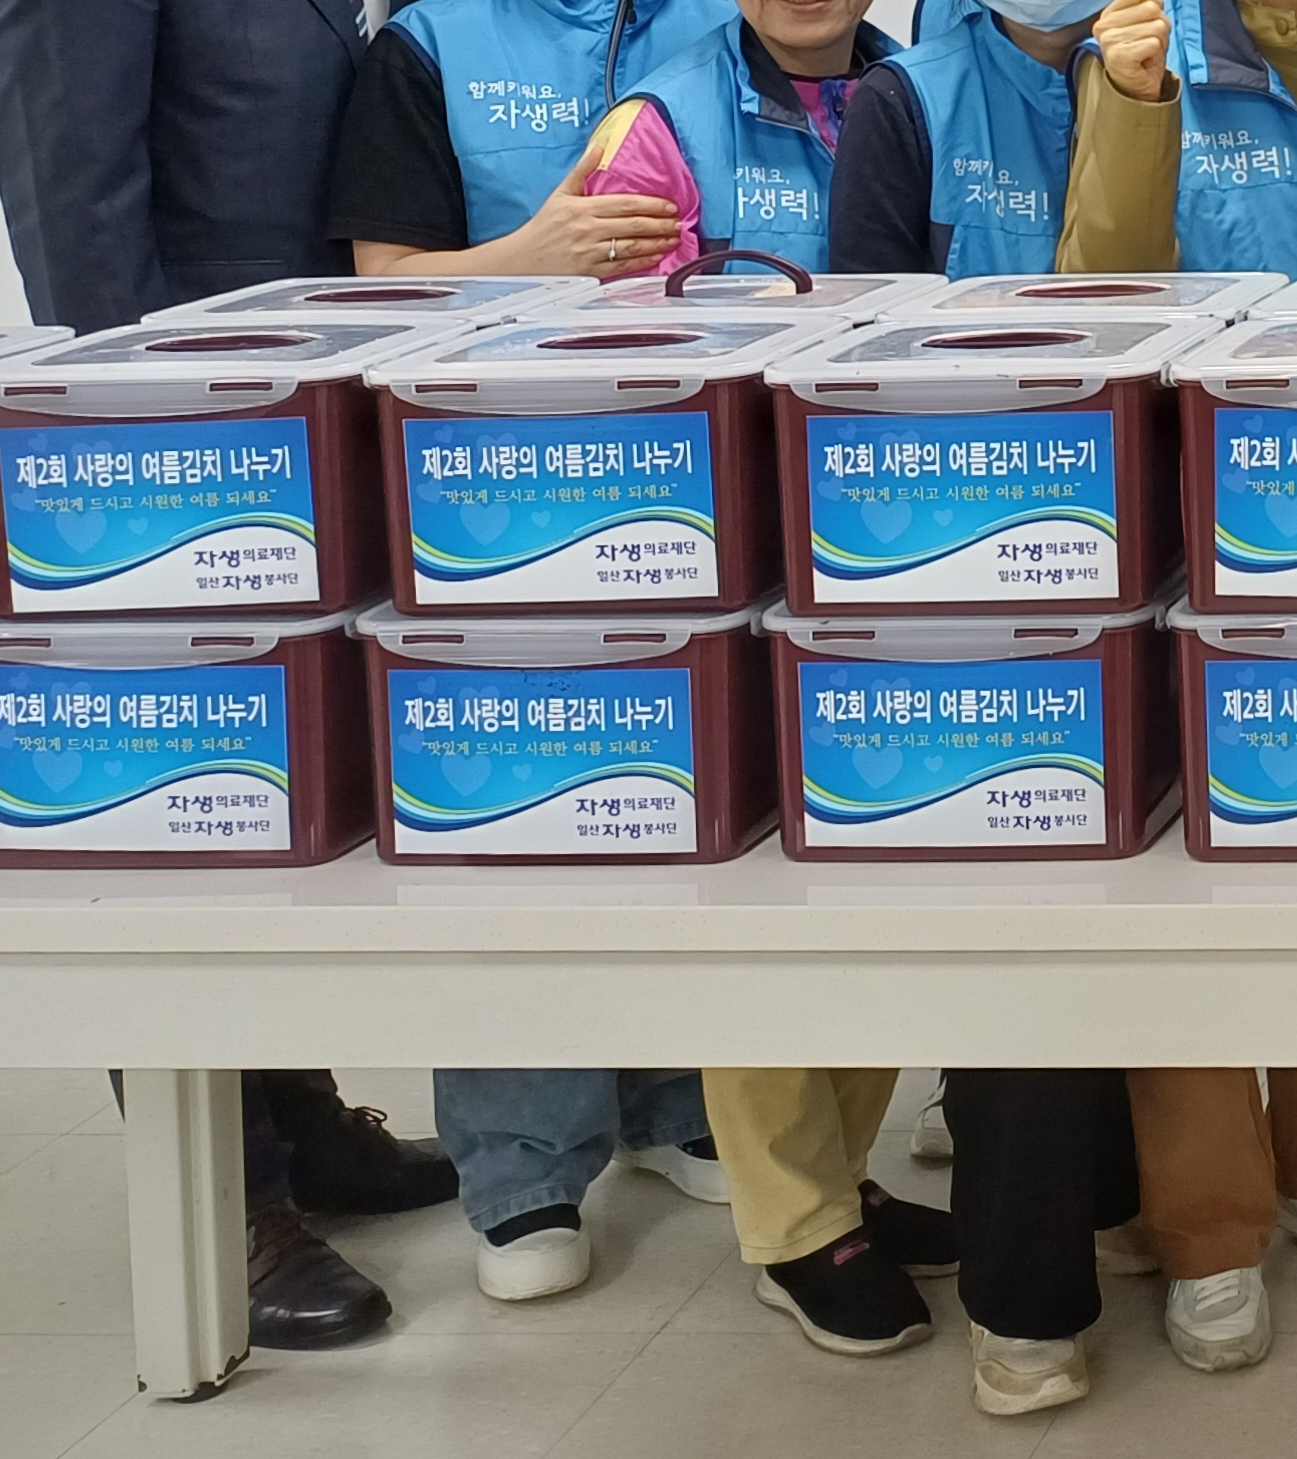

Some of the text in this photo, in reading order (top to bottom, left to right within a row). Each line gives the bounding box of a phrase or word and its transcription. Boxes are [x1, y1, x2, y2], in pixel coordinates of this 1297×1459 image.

[489, 97, 590, 132] 자생력!
[1196, 146, 1292, 185] 자생력!
[14, 445, 291, 490] 제2회 사랑의 여름김치 나누기
[420, 439, 693, 481] 제2회 사랑의 여름김치 나누기
[823, 438, 1096, 479] 제2회 사랑의 여름김치 나누기
[1229, 436, 1280, 471] 제2회
[493, 487, 539, 504] 드시고
[543, 486, 588, 503] 시원한
[592, 485, 622, 502] 여름
[193, 547, 296, 569] 자생의료재단
[595, 541, 696, 563] 자생의료재단
[996, 541, 1098, 563] 자생의료재단
[52, 693, 112, 729] 사랑의
[119, 693, 199, 729] 여름김치
[206, 693, 267, 729] 나누기
[402, 696, 674, 733] 제2회 사랑의 여름김치 나누기
[814, 687, 1085, 725] 제2회 사랑의 여름김치 나누기
[1221, 688, 1273, 724] 제2회
[167, 794, 269, 815] 자생의료재단
[575, 797, 676, 818] 자생의료재단
[986, 788, 1087, 809] 자생의료재단
